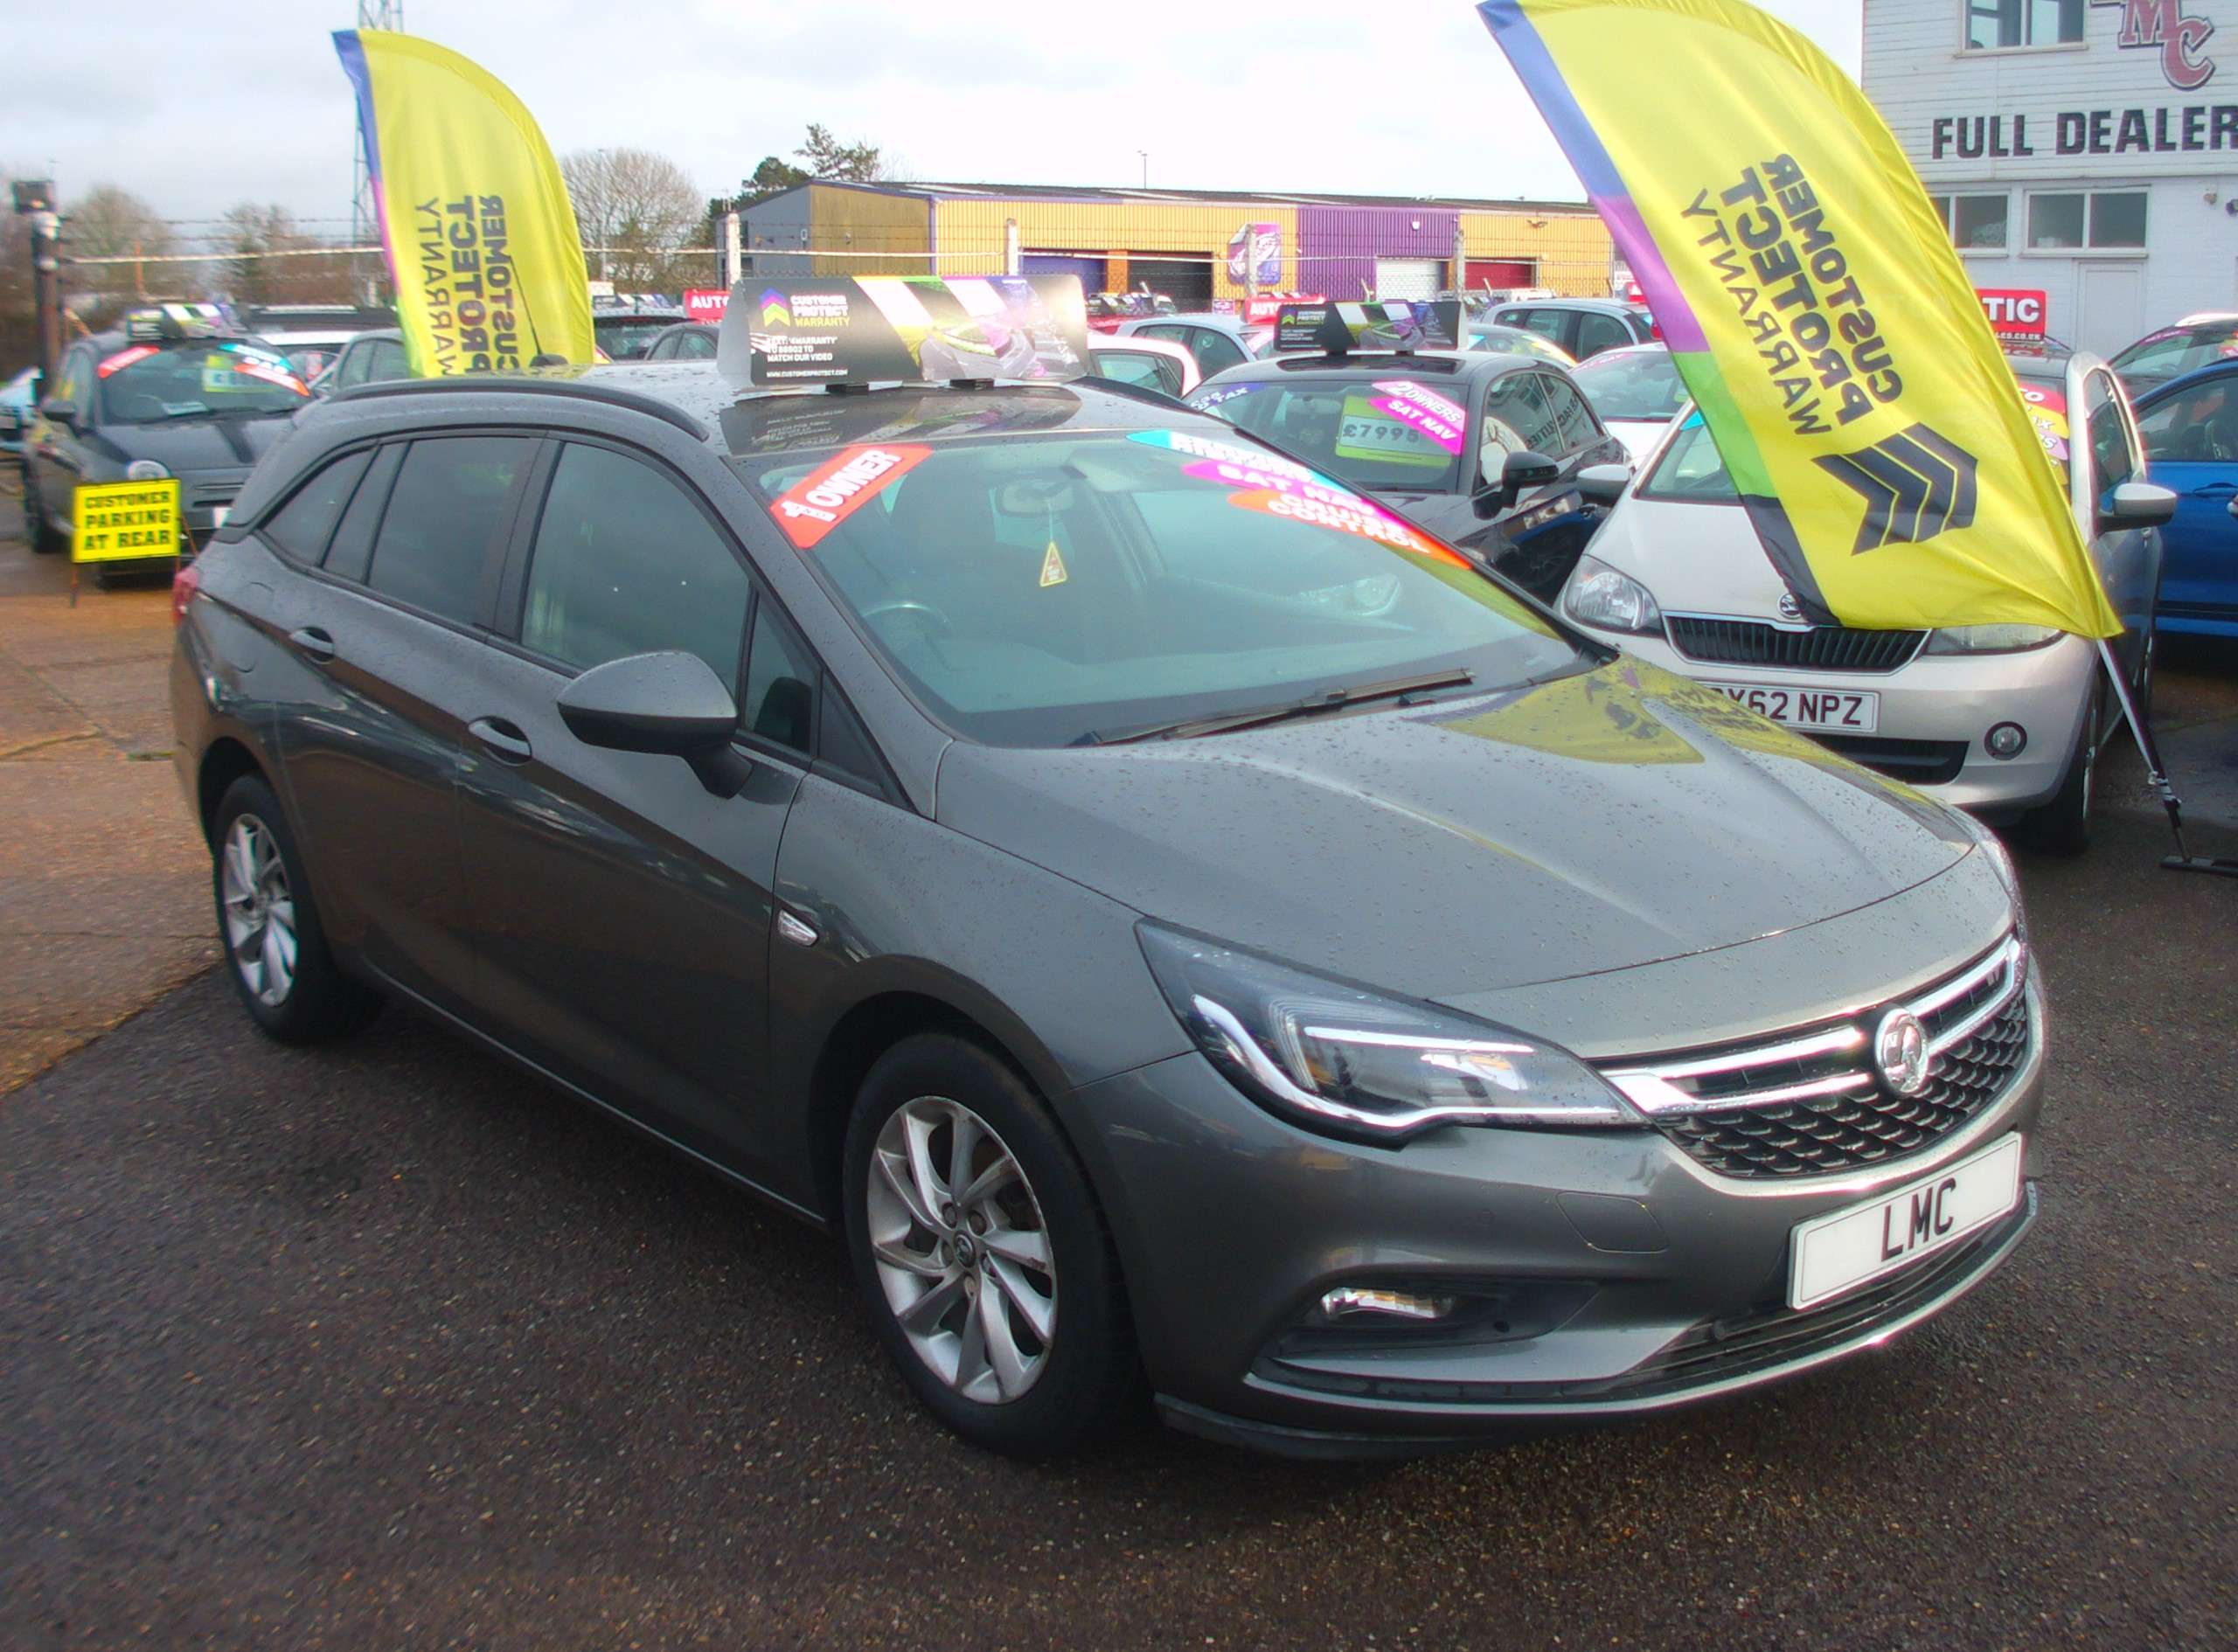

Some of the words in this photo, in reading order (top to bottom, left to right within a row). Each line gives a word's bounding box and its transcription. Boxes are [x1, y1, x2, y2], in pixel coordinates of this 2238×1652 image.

[2090, 0, 2216, 91] MC
[1932, 115, 2033, 160] FULL
[2056, 105, 2238, 156] DEALER
[793, 306, 848, 316] PROTECT
[795, 316, 850, 327] WARRANTY
[1982, 297, 2040, 323] TIC
[810, 352, 833, 361] VIDEO
[1388, 399, 1423, 420] SAT
[1420, 417, 1457, 439] NAV
[1406, 392, 1462, 422] OWNERS
[1343, 424, 1421, 443] £7995
[805, 449, 902, 507] OWNER
[1217, 464, 1292, 491] SAT
[1303, 485, 1375, 514] NAV
[85, 491, 170, 509] CUSTOMER
[781, 500, 837, 523] 1
[85, 510, 170, 529] PARKING
[1268, 501, 1431, 553] CONTROL
[1280, 494, 1407, 537] CRUISE
[84, 535, 108, 550] AT
[118, 531, 170, 548] REAR
[1799, 693, 1862, 725] NPZ
[1881, 1177, 1957, 1262] LMC
